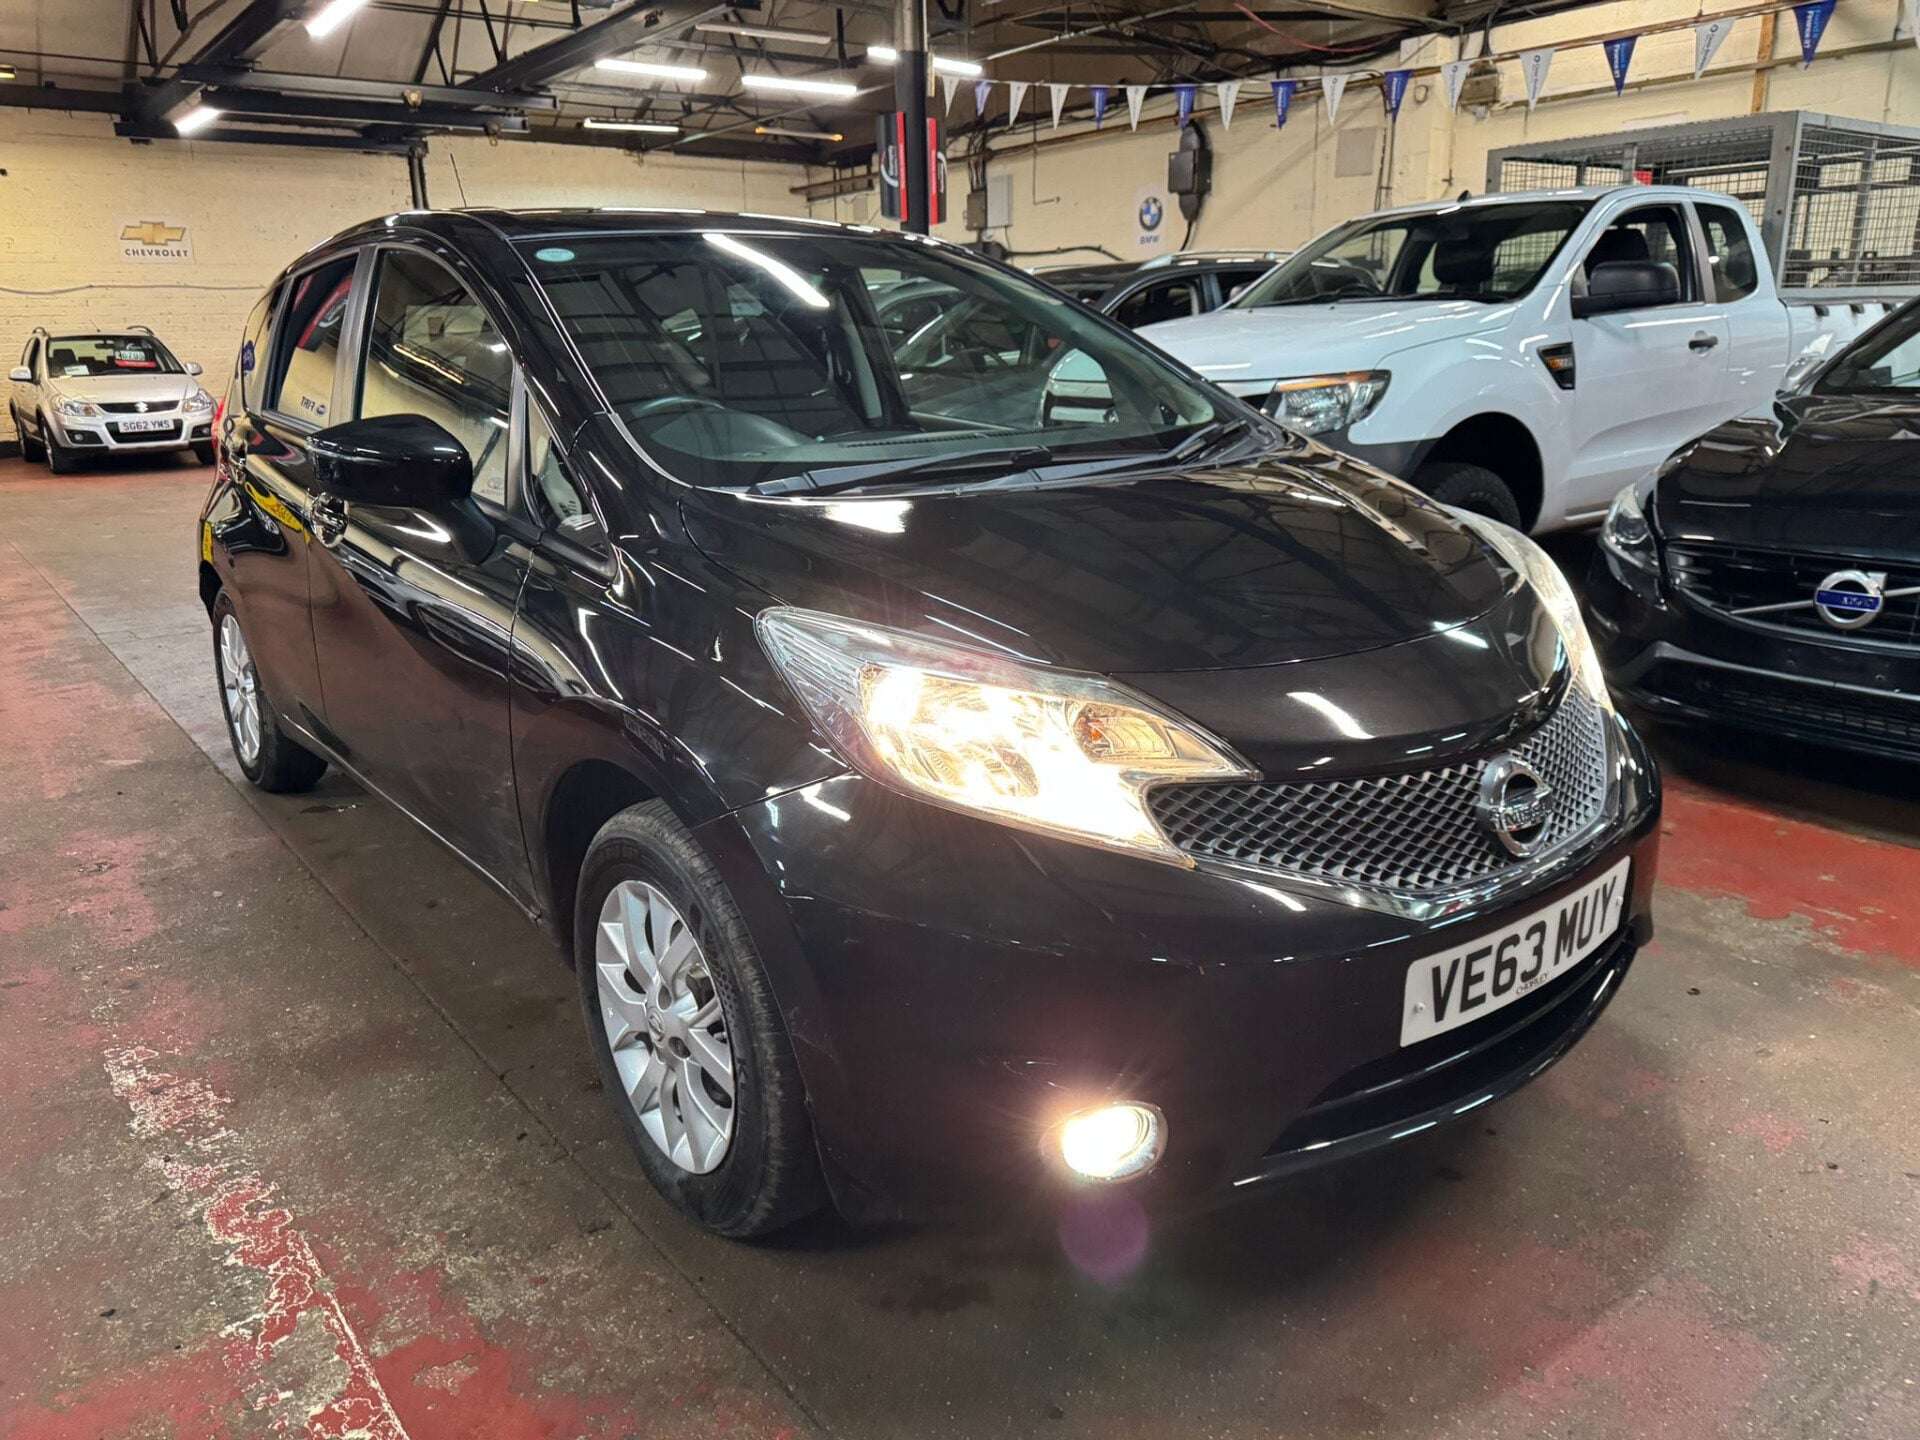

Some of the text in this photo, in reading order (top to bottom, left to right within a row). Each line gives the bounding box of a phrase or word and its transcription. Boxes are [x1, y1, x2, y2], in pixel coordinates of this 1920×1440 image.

[124, 248, 188, 257] CHEVROLET
[123, 420, 149, 431] SG62
[1432, 876, 1617, 1023] VE63 MUY
